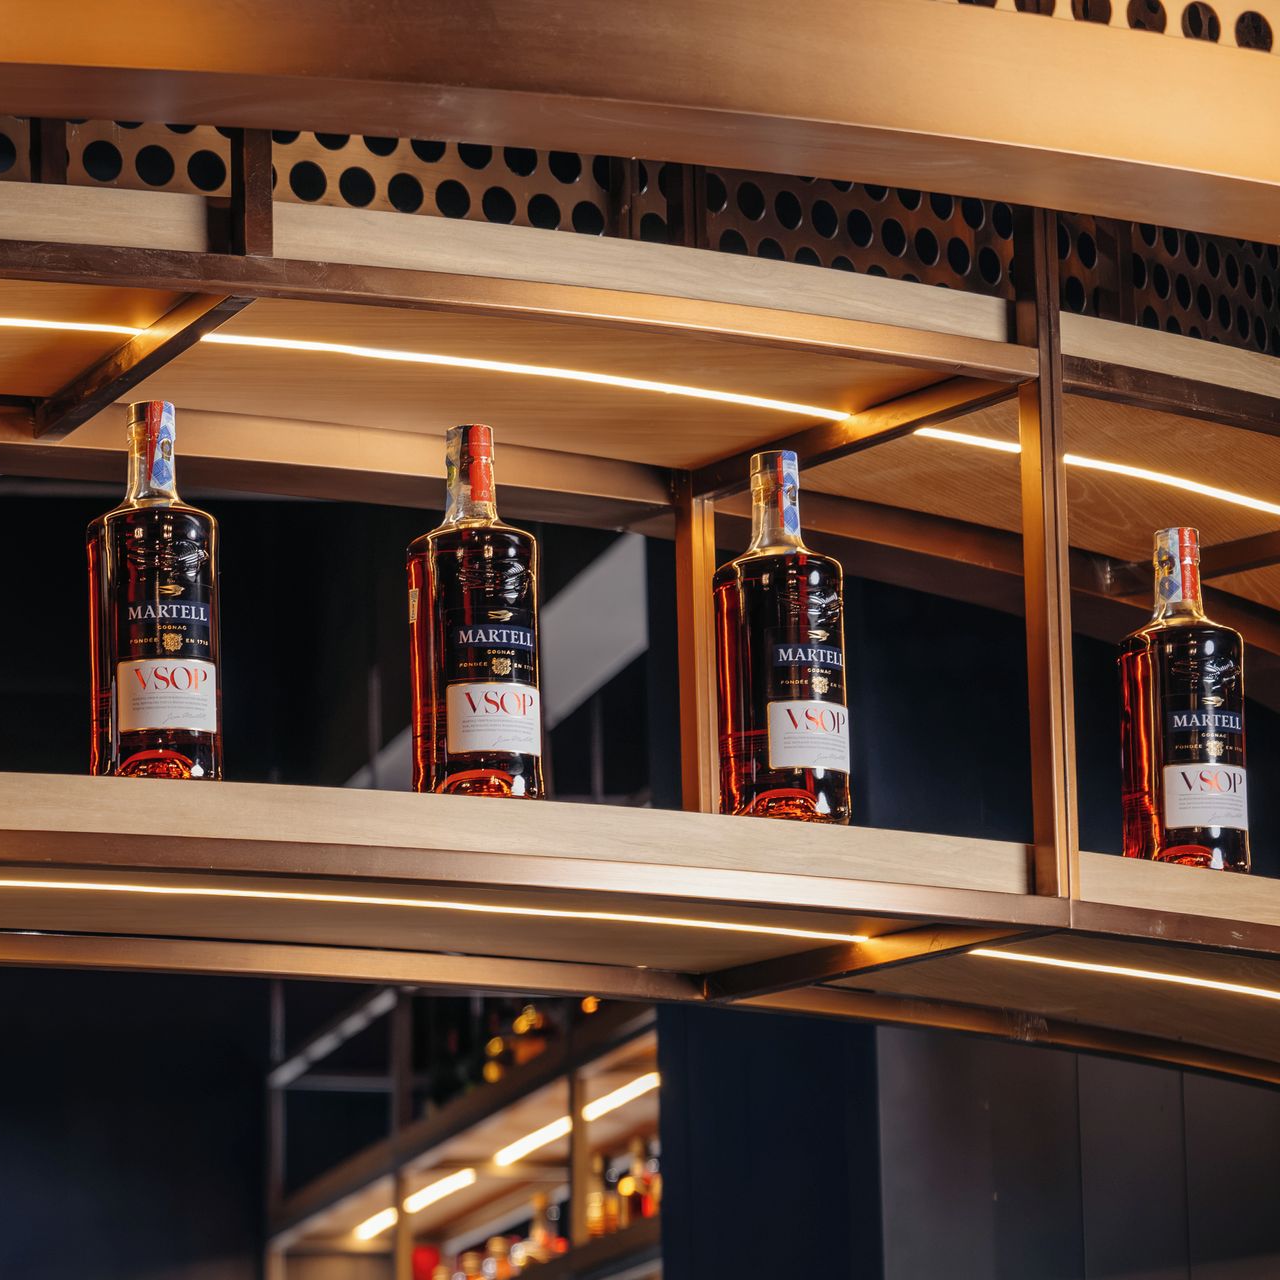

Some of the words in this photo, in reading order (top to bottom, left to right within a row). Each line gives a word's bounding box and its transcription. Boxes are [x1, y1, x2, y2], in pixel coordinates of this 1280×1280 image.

[128, 604, 208, 621] MARTELL
[458, 629, 533, 647] MARTELL
[778, 648, 844, 667] MARTELL
[134, 666, 208, 690] VSOP
[464, 690, 534, 716] VSOP
[786, 708, 846, 734] VSOP
[1173, 714, 1242, 730] MARTELL
[1180, 770, 1243, 793] VSOP
